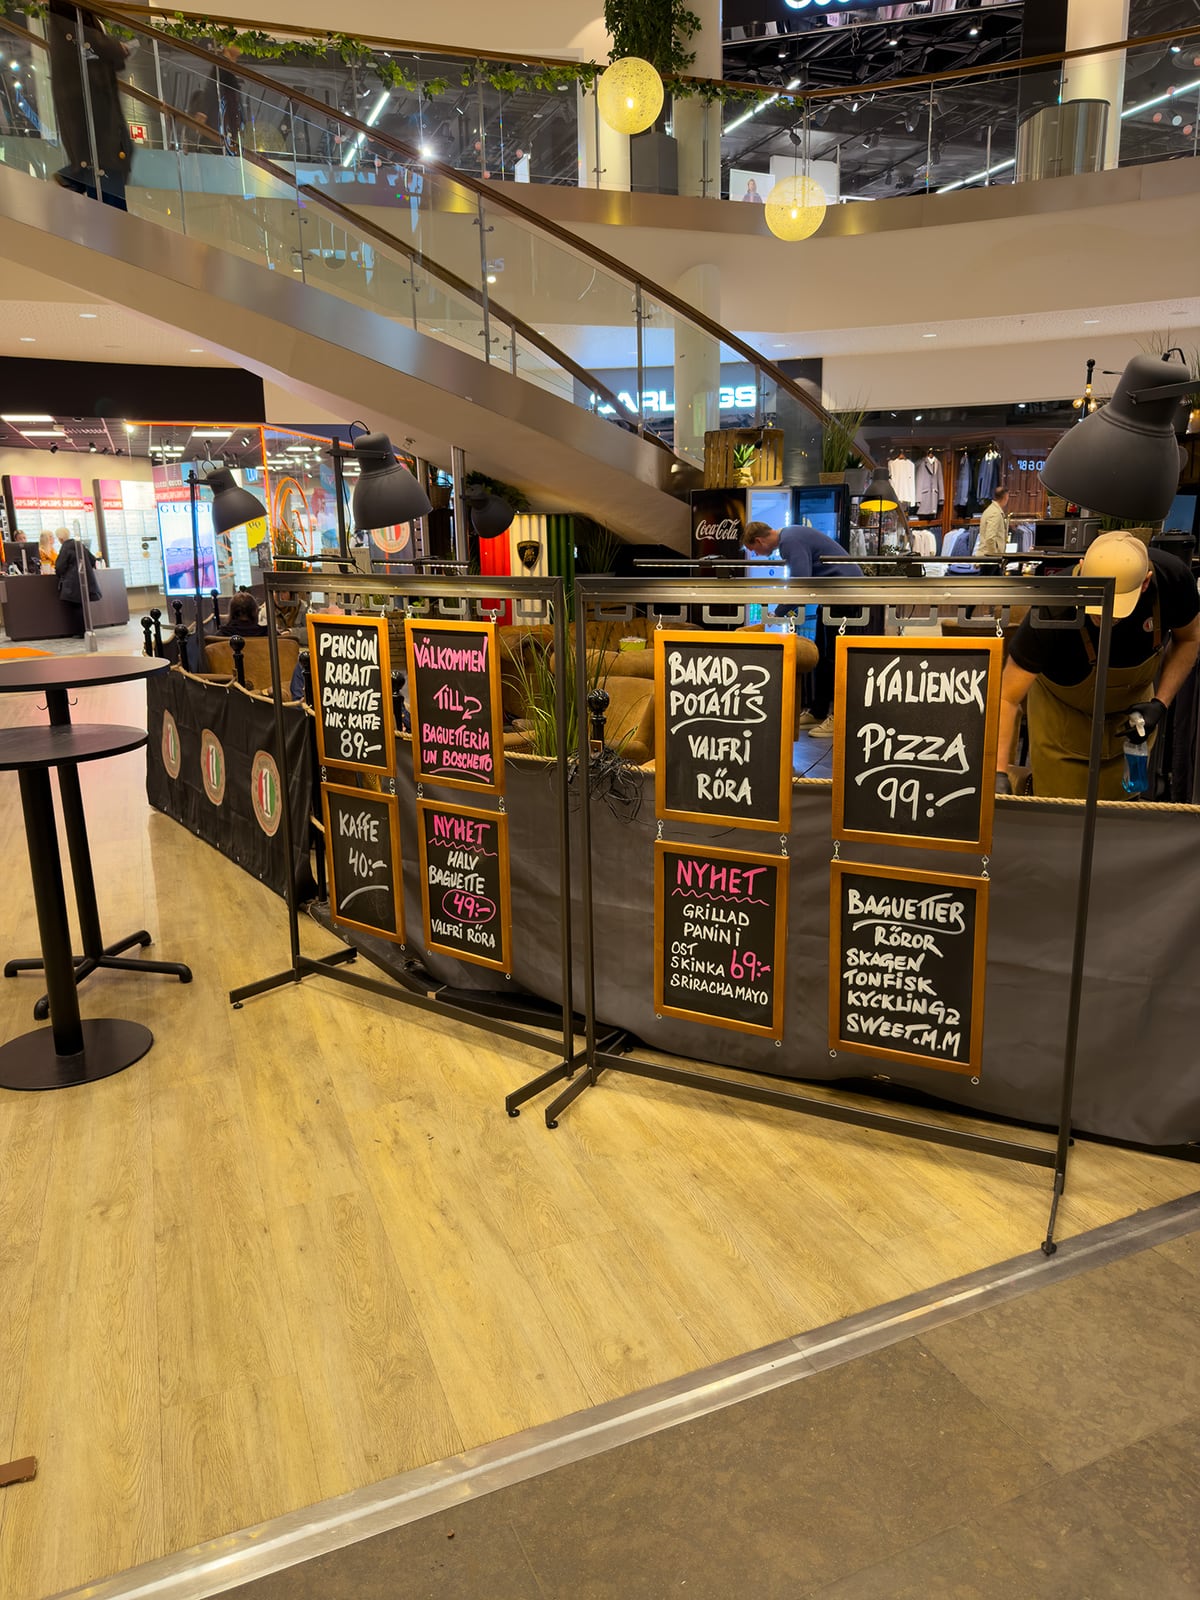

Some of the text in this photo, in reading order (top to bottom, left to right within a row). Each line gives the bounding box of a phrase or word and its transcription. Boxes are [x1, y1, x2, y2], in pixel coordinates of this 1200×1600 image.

[695, 518, 740, 541] Coca-Cola
[319, 629, 378, 665] PENSION
[413, 636, 488, 673] VÄLKOMMEN
[324, 661, 380, 687] RABATT
[668, 651, 739, 687] BAKAD
[322, 686, 382, 712] BAGUETTE
[433, 684, 463, 712] TILL
[864, 656, 987, 714] ITALIENSK
[669, 683, 768, 725] POTATIS
[340, 729, 382, 760] 89:-
[422, 723, 490, 750] BAGUETTERIA
[687, 729, 753, 766] VALFRI
[423, 749, 493, 773] UN BOSCHETTO
[696, 767, 753, 805] RÖRA
[876, 777, 976, 822] 99:-
[338, 808, 380, 843] KAFFE
[433, 814, 491, 845] NYHET
[348, 847, 388, 878] 40:-
[446, 850, 480, 871] HALV
[428, 864, 486, 895] BAGUETTE
[677, 859, 768, 896] NYHET
[453, 892, 491, 918] 49:-
[682, 903, 750, 927] GRILLAD
[847, 888, 966, 929] BAGUETTER
[431, 918, 496, 949] VALFRI RÖRA
[671, 941, 698, 956] OST
[874, 925, 944, 958] RÖROR
[670, 956, 726, 978] SKINKA
[845, 947, 926, 973] SKAGEN
[842, 968, 937, 996] TONFISK
